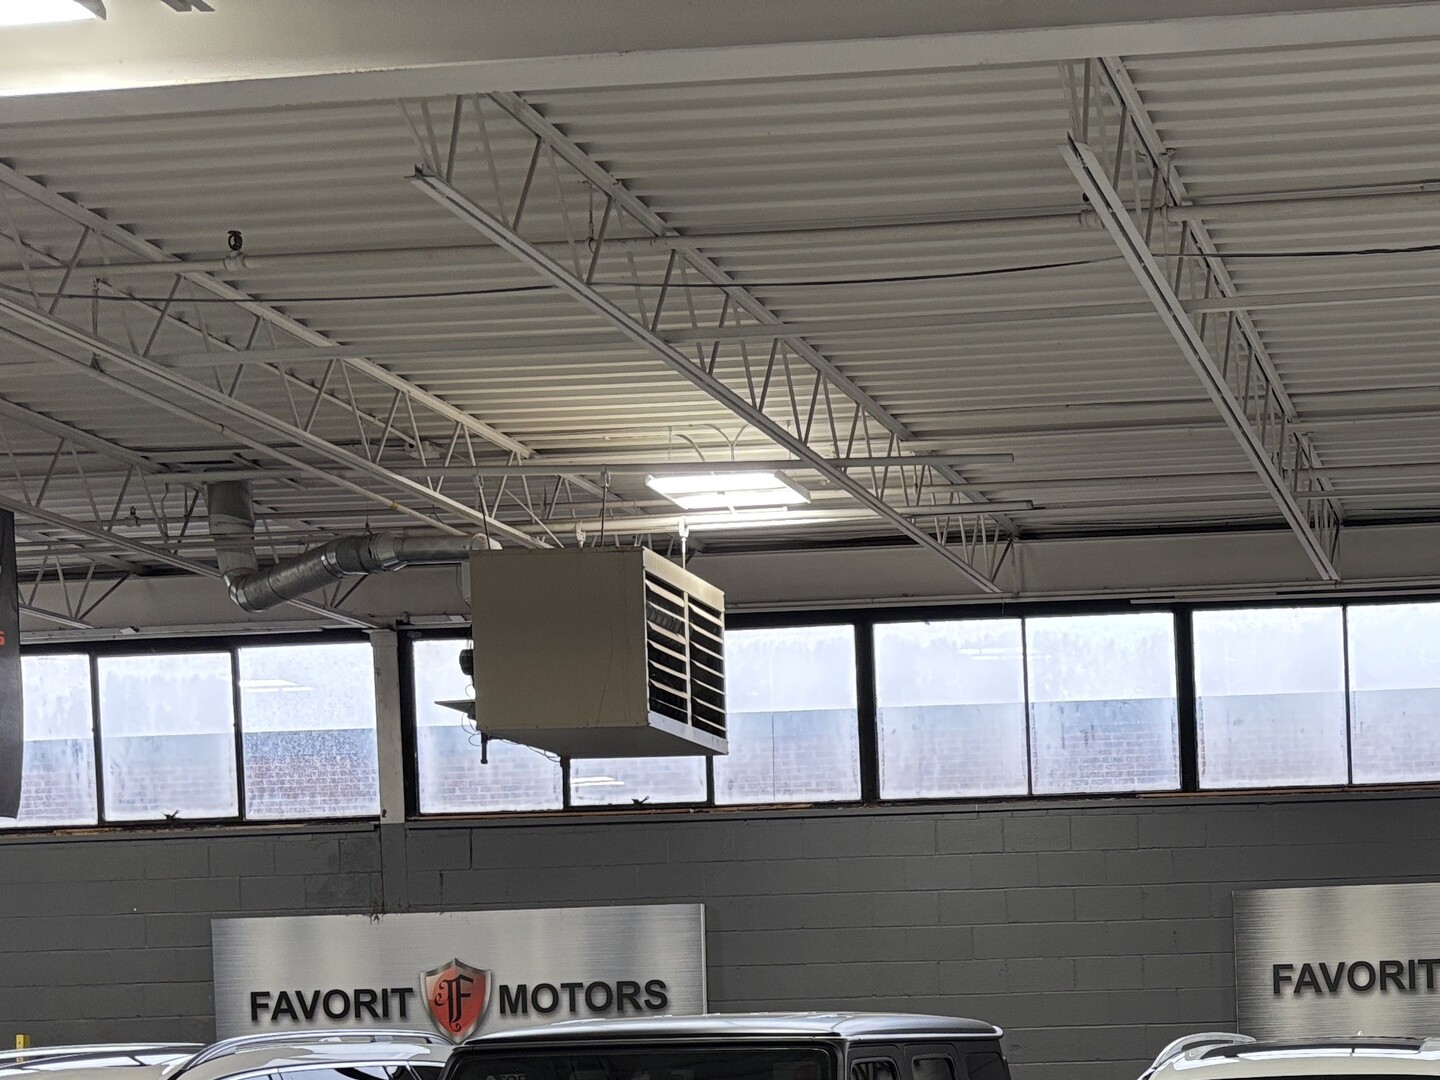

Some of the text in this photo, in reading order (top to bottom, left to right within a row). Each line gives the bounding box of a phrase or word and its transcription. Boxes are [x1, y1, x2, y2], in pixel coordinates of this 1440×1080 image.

[1272, 958, 1440, 995] FAVORIT
[249, 979, 668, 1021] FAVORIT MOTORS
